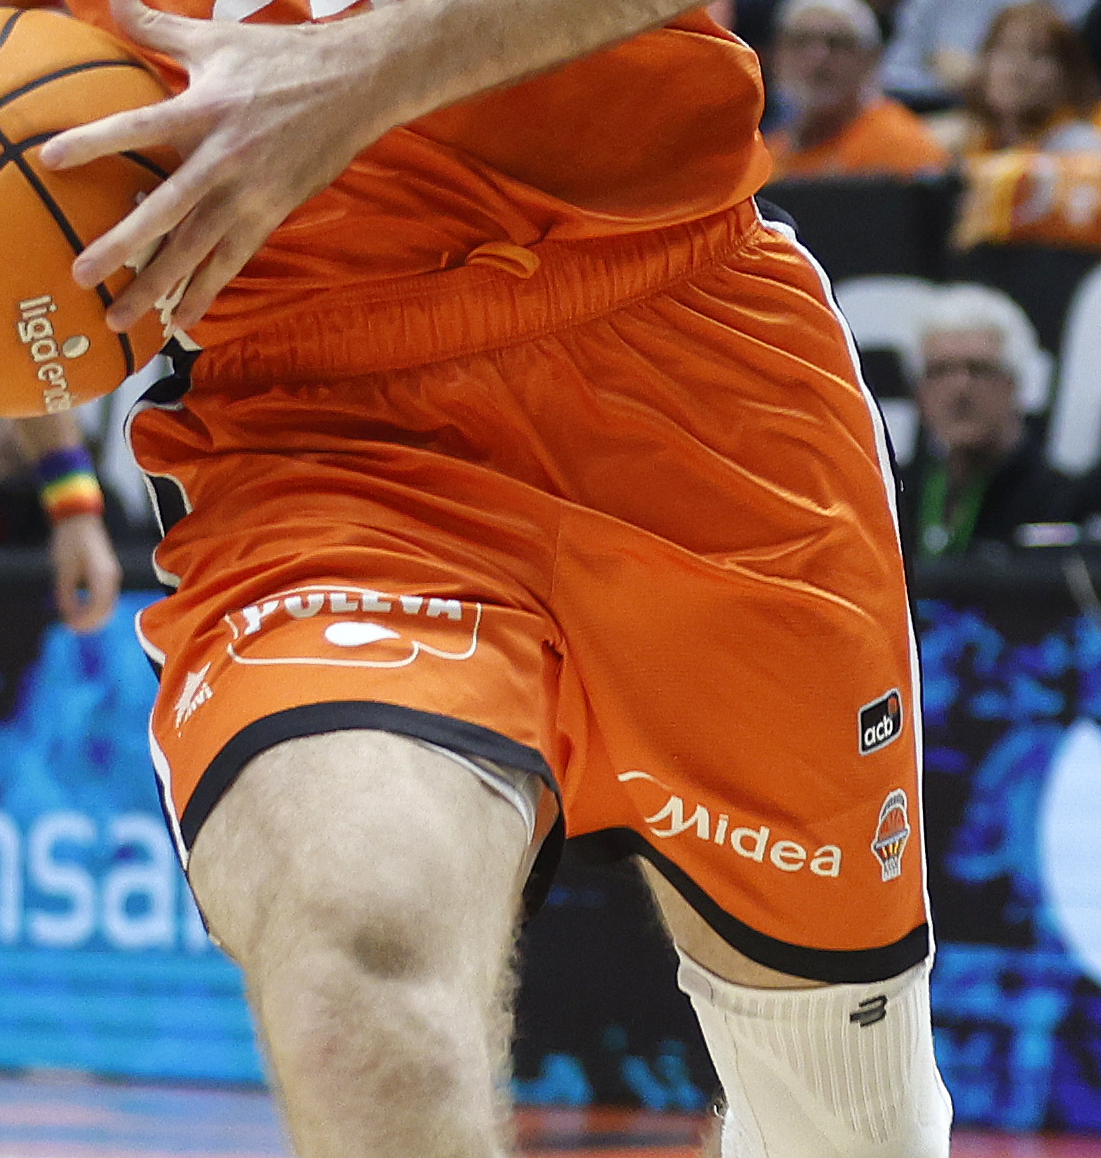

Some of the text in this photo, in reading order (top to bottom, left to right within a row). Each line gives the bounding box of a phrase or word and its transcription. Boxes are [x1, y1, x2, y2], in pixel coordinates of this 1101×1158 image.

[18, 295, 60, 362] liga
[864, 715, 894, 746] acb
[644, 795, 842, 877] Midea
